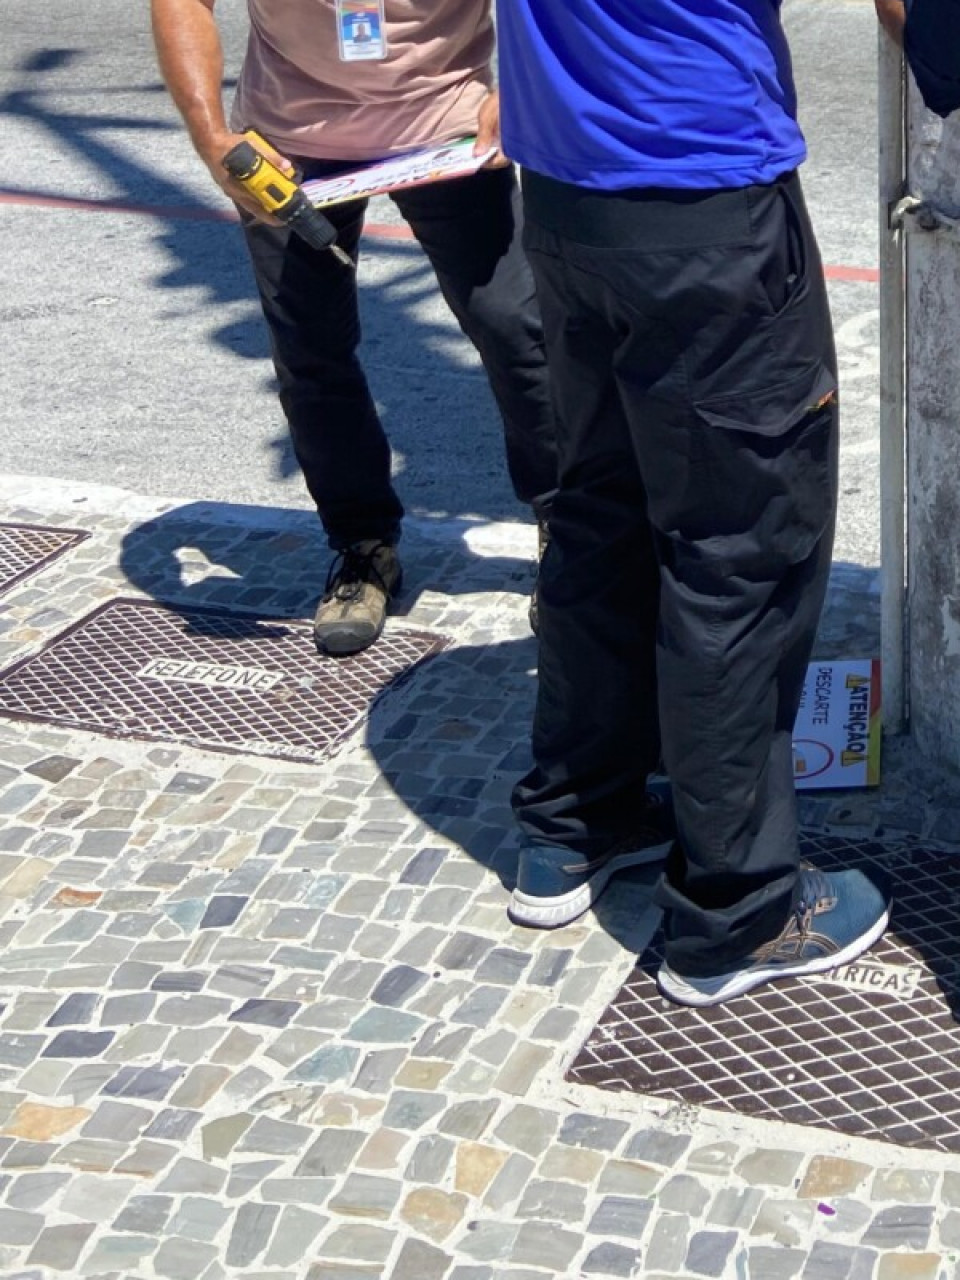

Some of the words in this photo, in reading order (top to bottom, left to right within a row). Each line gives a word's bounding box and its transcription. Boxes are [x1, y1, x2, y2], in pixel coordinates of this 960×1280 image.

[145, 660, 277, 690] TELEFONE
[812, 666, 833, 725] DESCARTE
[843, 683, 870, 753] ATENÇÃO
